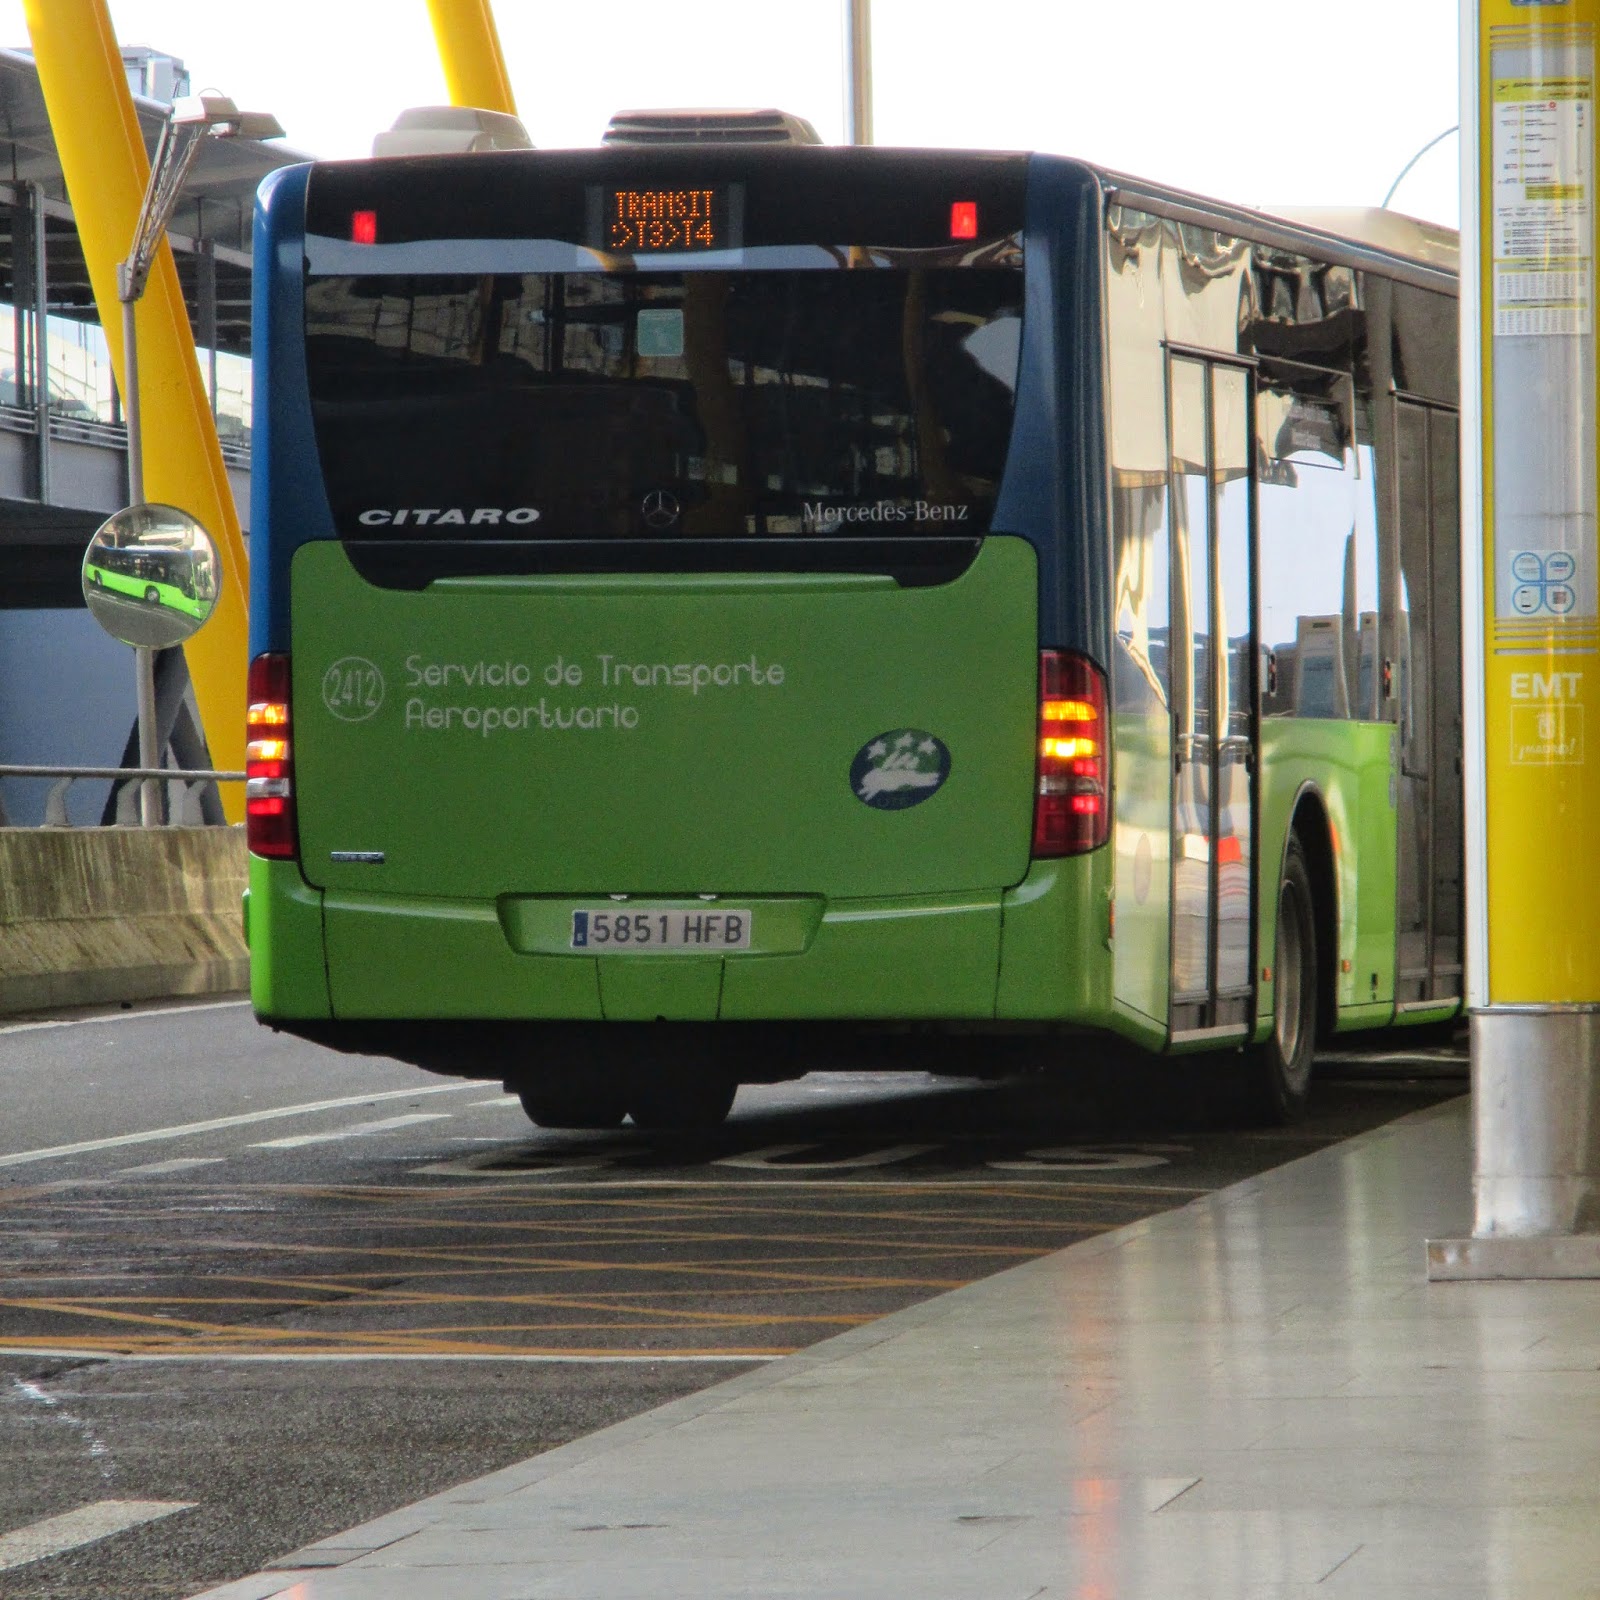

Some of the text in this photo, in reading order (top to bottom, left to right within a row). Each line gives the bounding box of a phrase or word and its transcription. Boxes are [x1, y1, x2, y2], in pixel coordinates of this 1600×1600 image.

[615, 190, 714, 218] TRANSIT
[358, 507, 540, 526] CITARO
[802, 501, 969, 522] Mercedes-Benz
[329, 668, 377, 707] 2412
[405, 654, 786, 696] Servicio de Transporte
[1510, 671, 1584, 699] EMT
[405, 697, 640, 738] Aeroportuario
[593, 914, 744, 943] 5851 HFB
